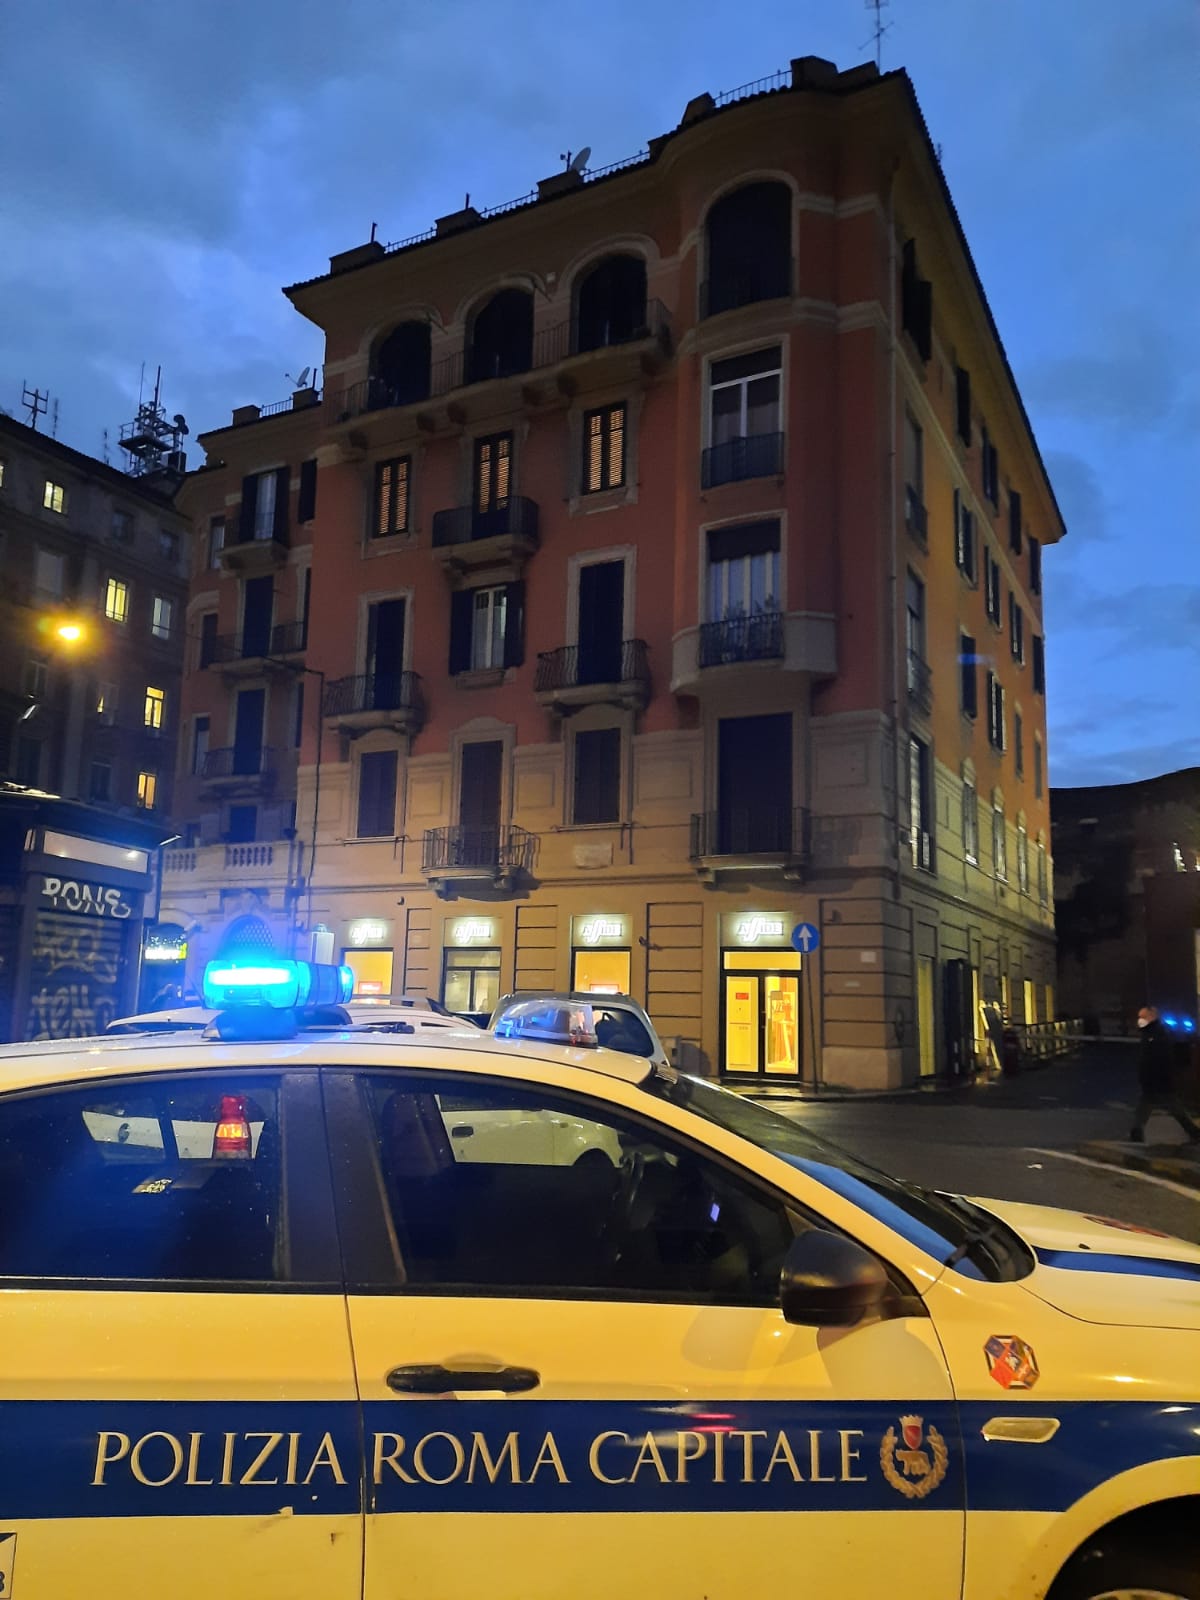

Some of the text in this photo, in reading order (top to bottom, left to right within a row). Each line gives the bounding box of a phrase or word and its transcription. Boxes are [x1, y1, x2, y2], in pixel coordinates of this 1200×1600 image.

[90, 1429, 868, 1487] POLIZIA ROMA CAPITALE
